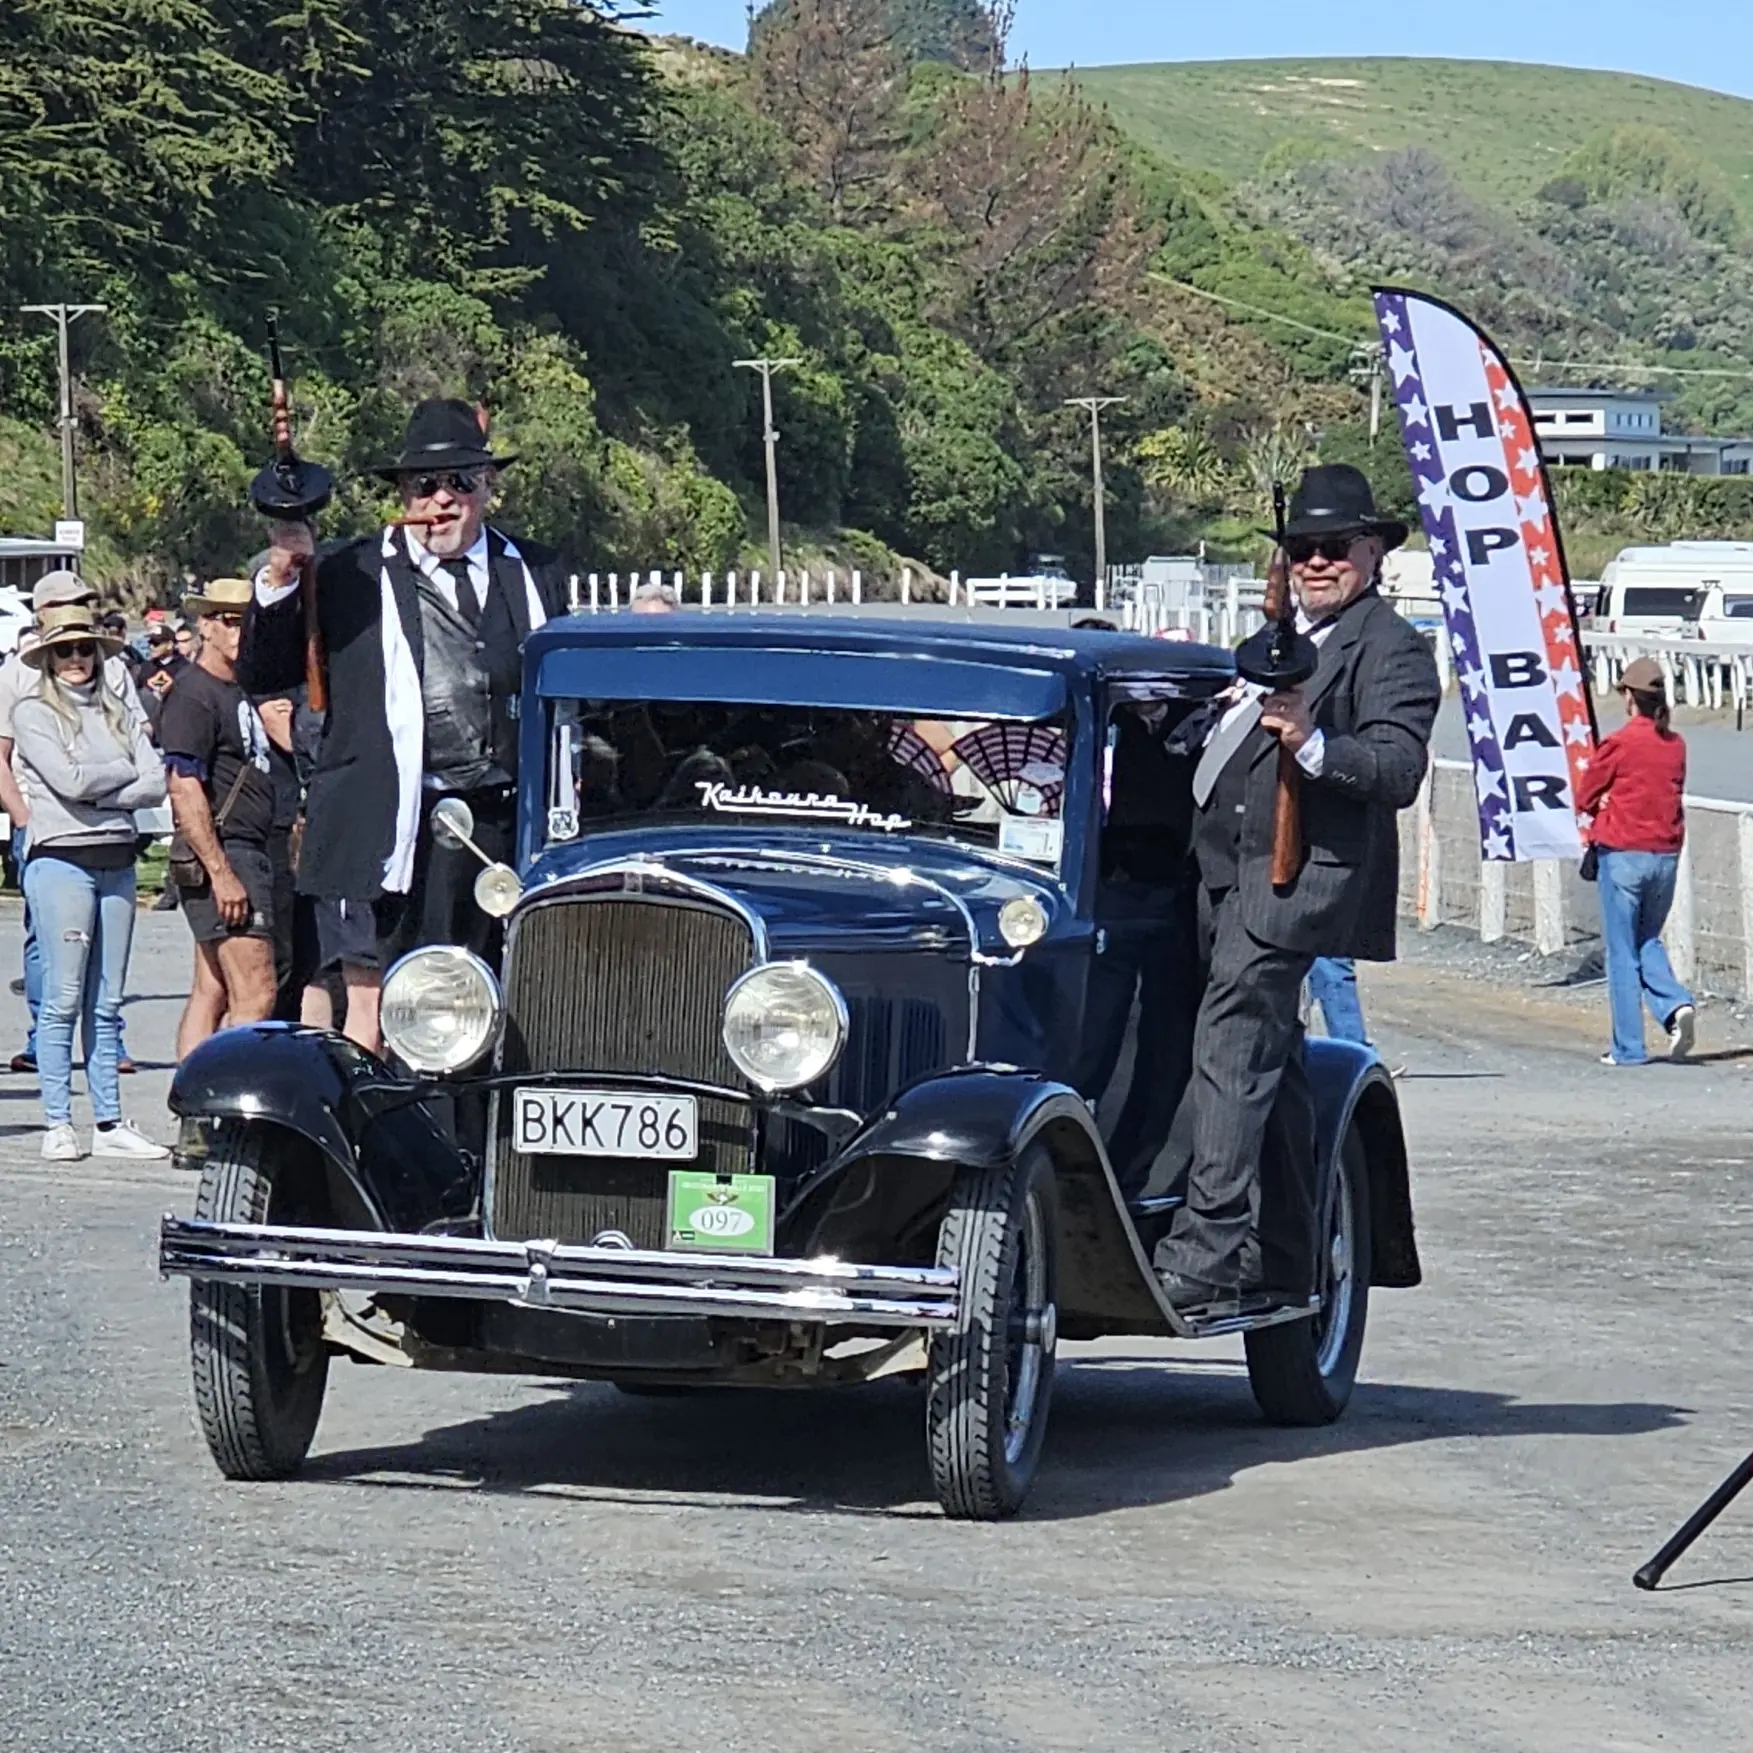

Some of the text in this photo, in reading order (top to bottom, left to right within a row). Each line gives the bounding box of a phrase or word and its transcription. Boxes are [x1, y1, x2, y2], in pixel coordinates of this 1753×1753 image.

[1434, 401, 1569, 812] HOP BAR
[848, 803, 912, 831] Hop
[521, 1098, 688, 1151] BKK786
[701, 1210, 743, 1232] 097
